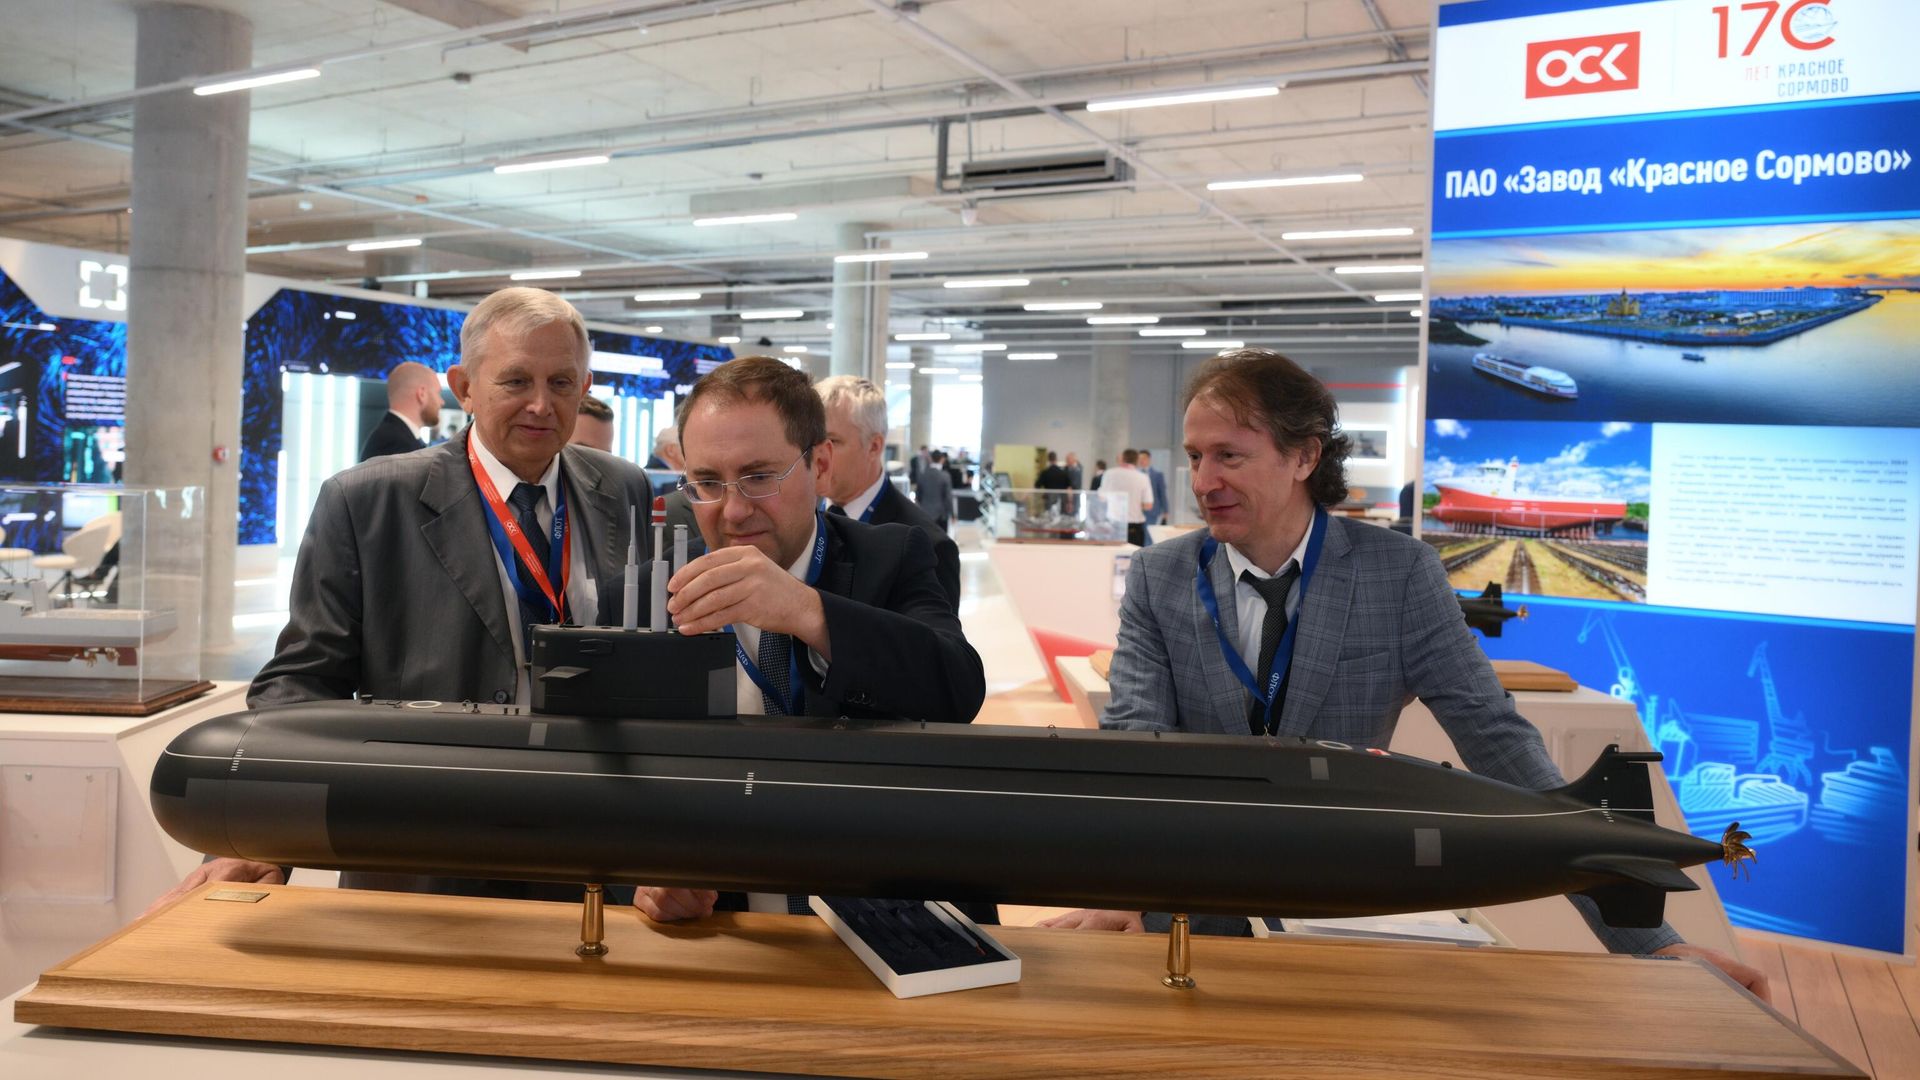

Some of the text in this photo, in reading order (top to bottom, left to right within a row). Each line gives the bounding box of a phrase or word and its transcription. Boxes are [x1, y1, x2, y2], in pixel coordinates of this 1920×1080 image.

[1535, 42, 1629, 88] ОСК
[1778, 58, 1846, 79] КРАСНОЕ
[1777, 77, 1849, 97] СОРМОВО
[1445, 149, 1913, 199] ПАО «Завод «Красное Сормово»
